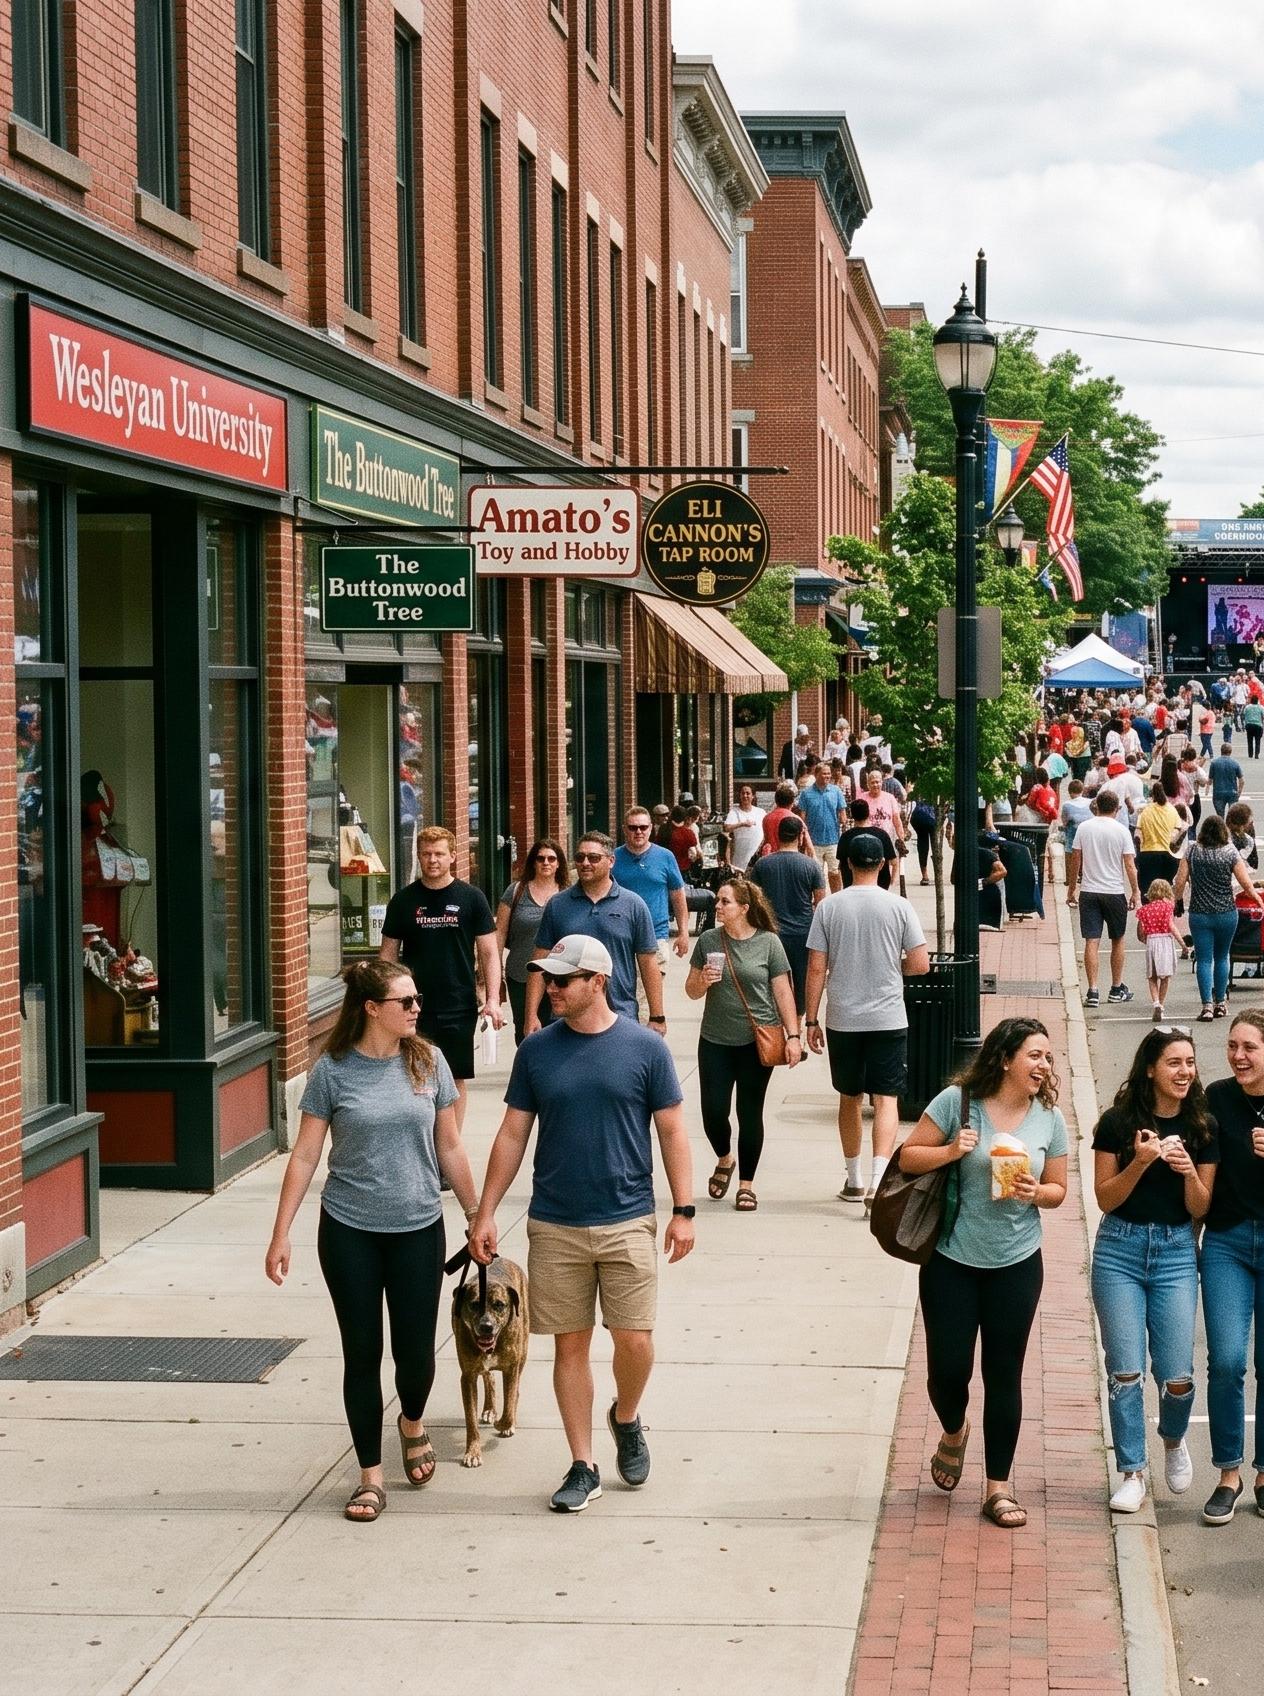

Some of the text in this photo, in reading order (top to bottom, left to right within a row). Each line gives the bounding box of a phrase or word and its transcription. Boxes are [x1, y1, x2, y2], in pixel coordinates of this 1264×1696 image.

[49, 333, 273, 478] Wesleyan University
[324, 429, 454, 519] The Buttonwood Tree
[478, 497, 631, 534] Amato's
[687, 499, 723, 518] ELI
[649, 523, 762, 543] CANNON'S
[477, 541, 630, 565] Toy and Hobby
[658, 547, 754, 562] TAP ROOM
[375, 554, 420, 574] The
[328, 577, 467, 598] Buttonwood
[372, 601, 424, 621] Tree
